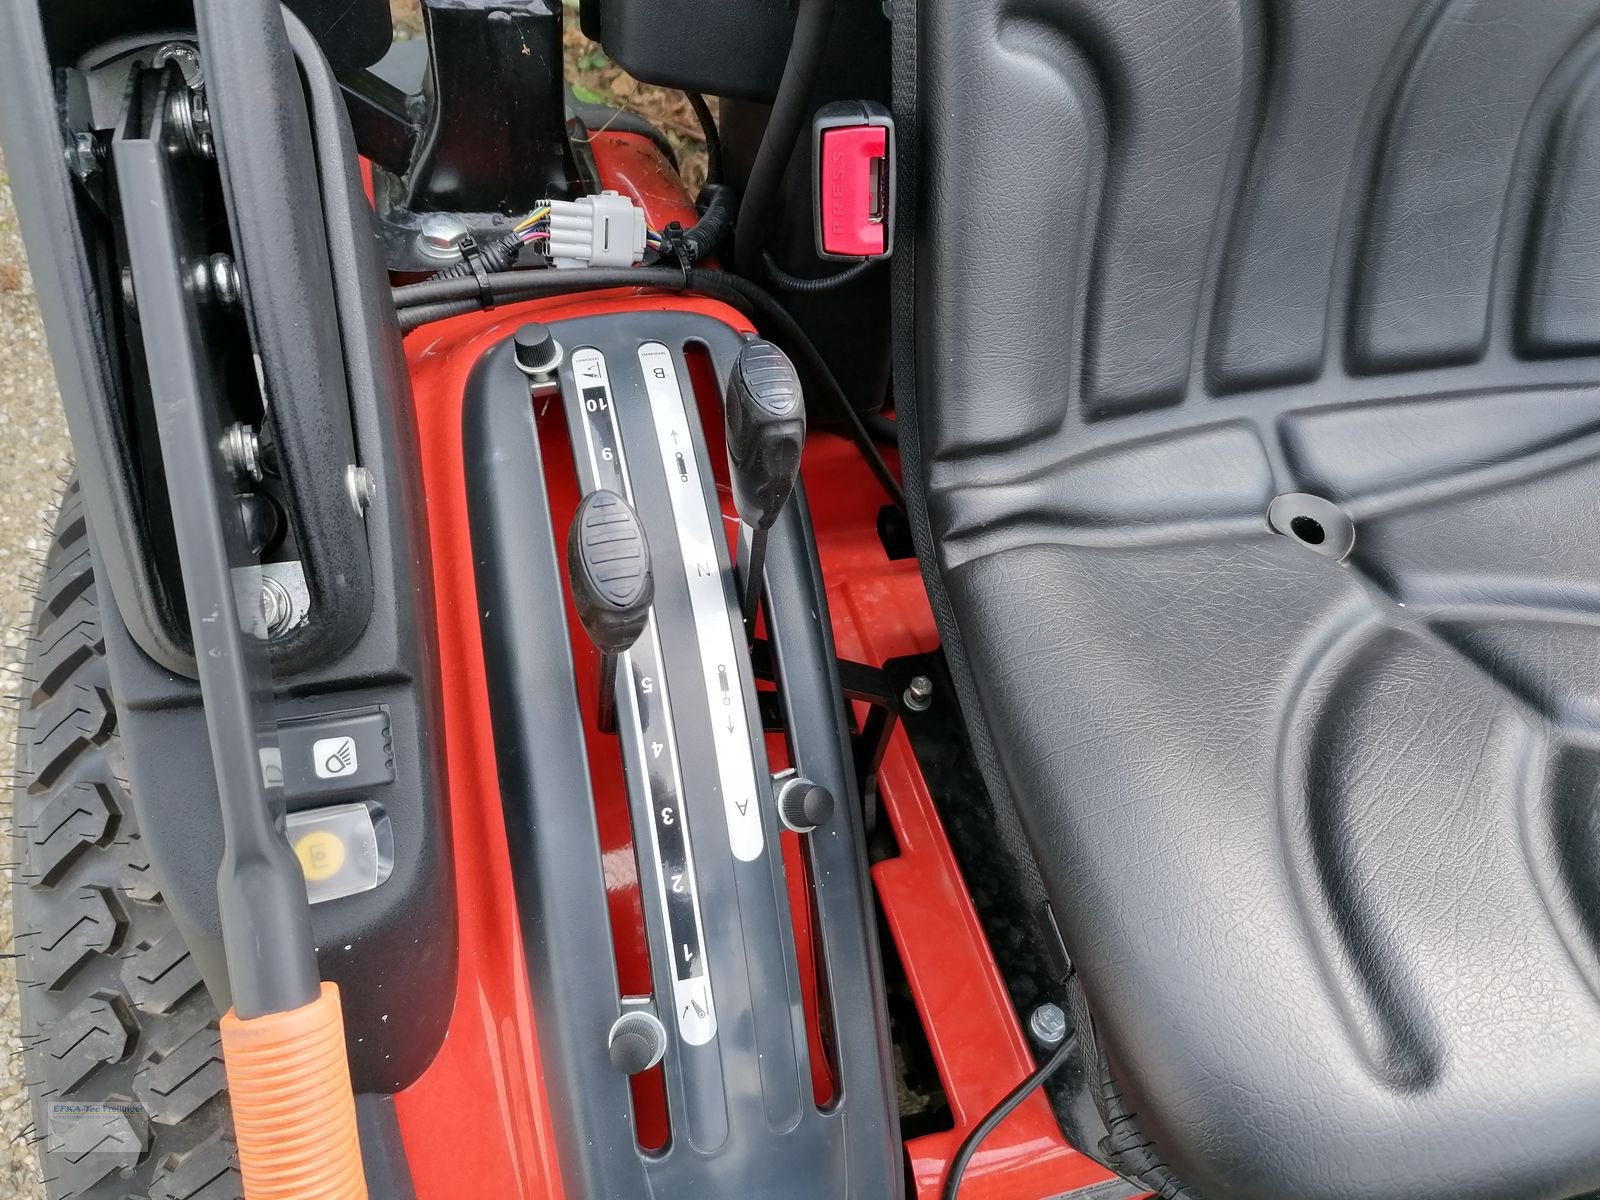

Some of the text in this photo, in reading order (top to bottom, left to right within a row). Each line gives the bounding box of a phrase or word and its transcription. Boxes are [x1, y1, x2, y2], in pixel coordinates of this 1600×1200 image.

[832, 151, 846, 235] PRESS
[653, 368, 666, 379] B
[586, 397, 607, 412] 10
[641, 677, 653, 694] 5
[651, 741, 664, 759] 4
[661, 807, 674, 825] 3
[735, 799, 749, 816] A
[671, 875, 684, 892] 2
[683, 944, 693, 961] 1
